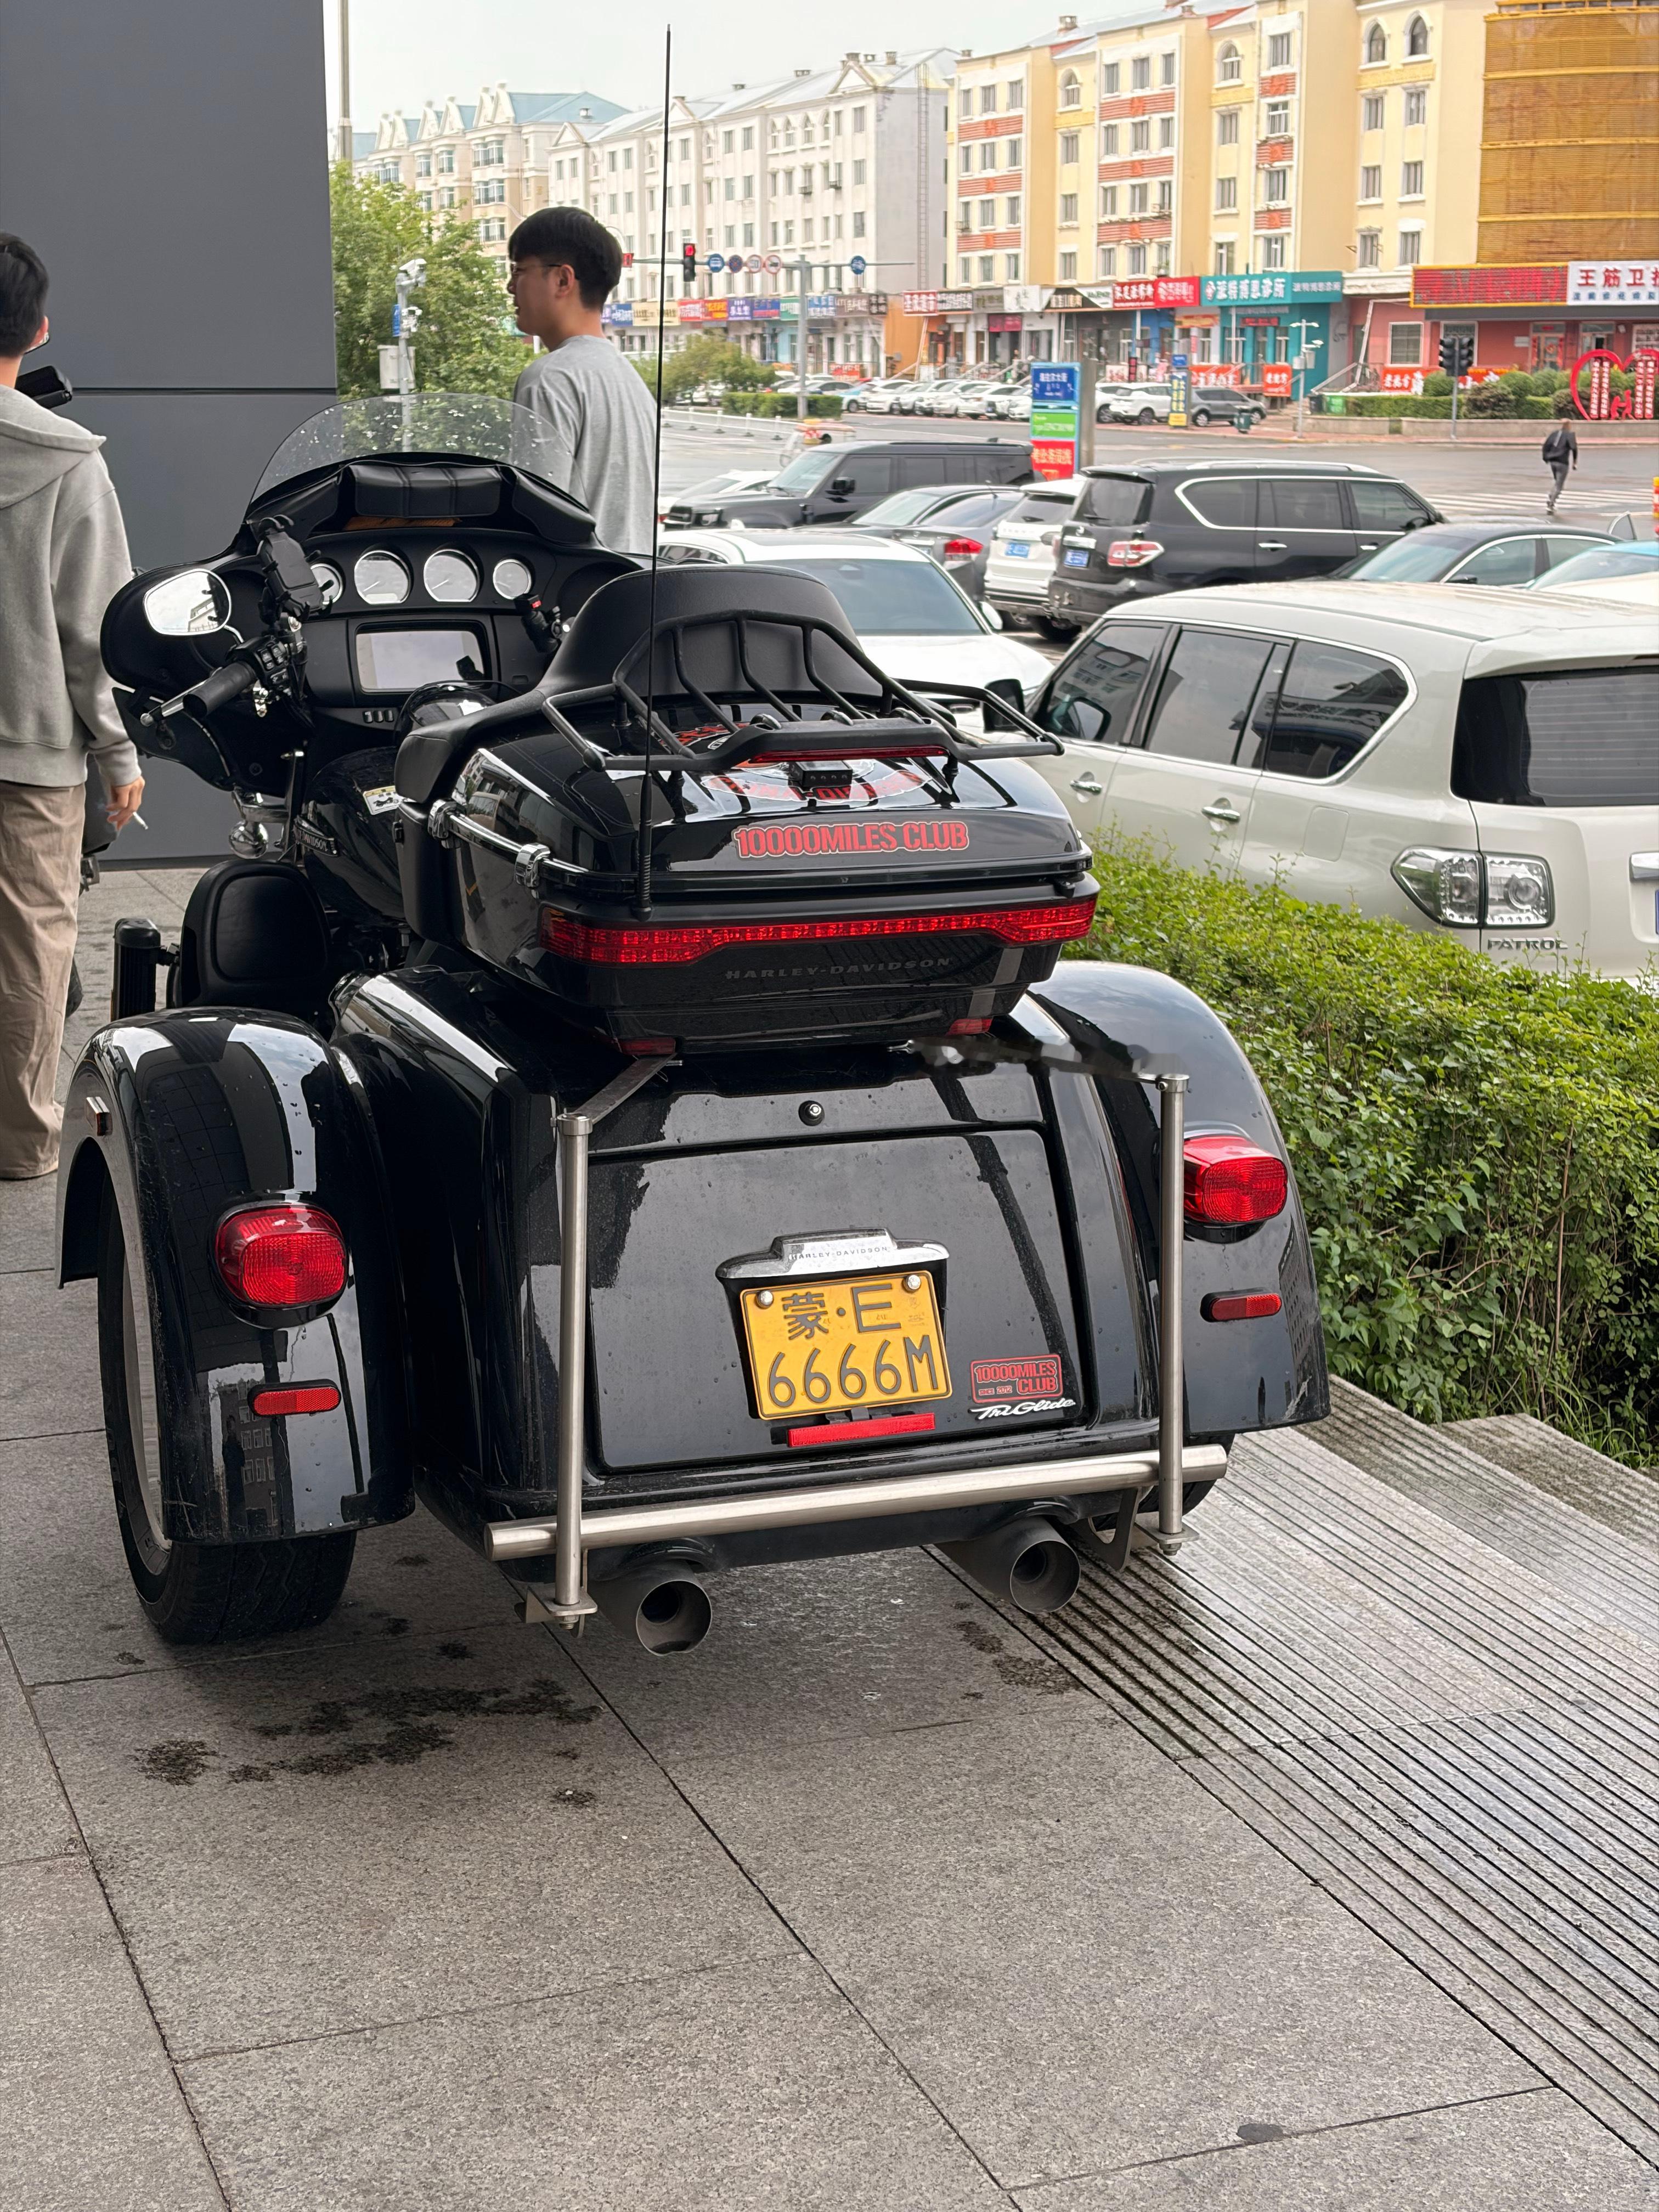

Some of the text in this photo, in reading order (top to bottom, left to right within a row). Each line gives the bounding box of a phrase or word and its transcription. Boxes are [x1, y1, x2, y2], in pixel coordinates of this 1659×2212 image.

[735, 822, 969, 857] 10000MILES CLUB
[1487, 937, 1568, 951] PATROL
[726, 958, 951, 979] HARLEY-DAVIDSON
[788, 1246, 888, 1260] HARLEY-DAVIDSON
[768, 1334, 939, 1408] 6666M
[975, 1361, 1057, 1383] 10000MILES
[996, 1385, 1012, 1394] 2012
[1017, 1376, 1058, 1394] CLUB
